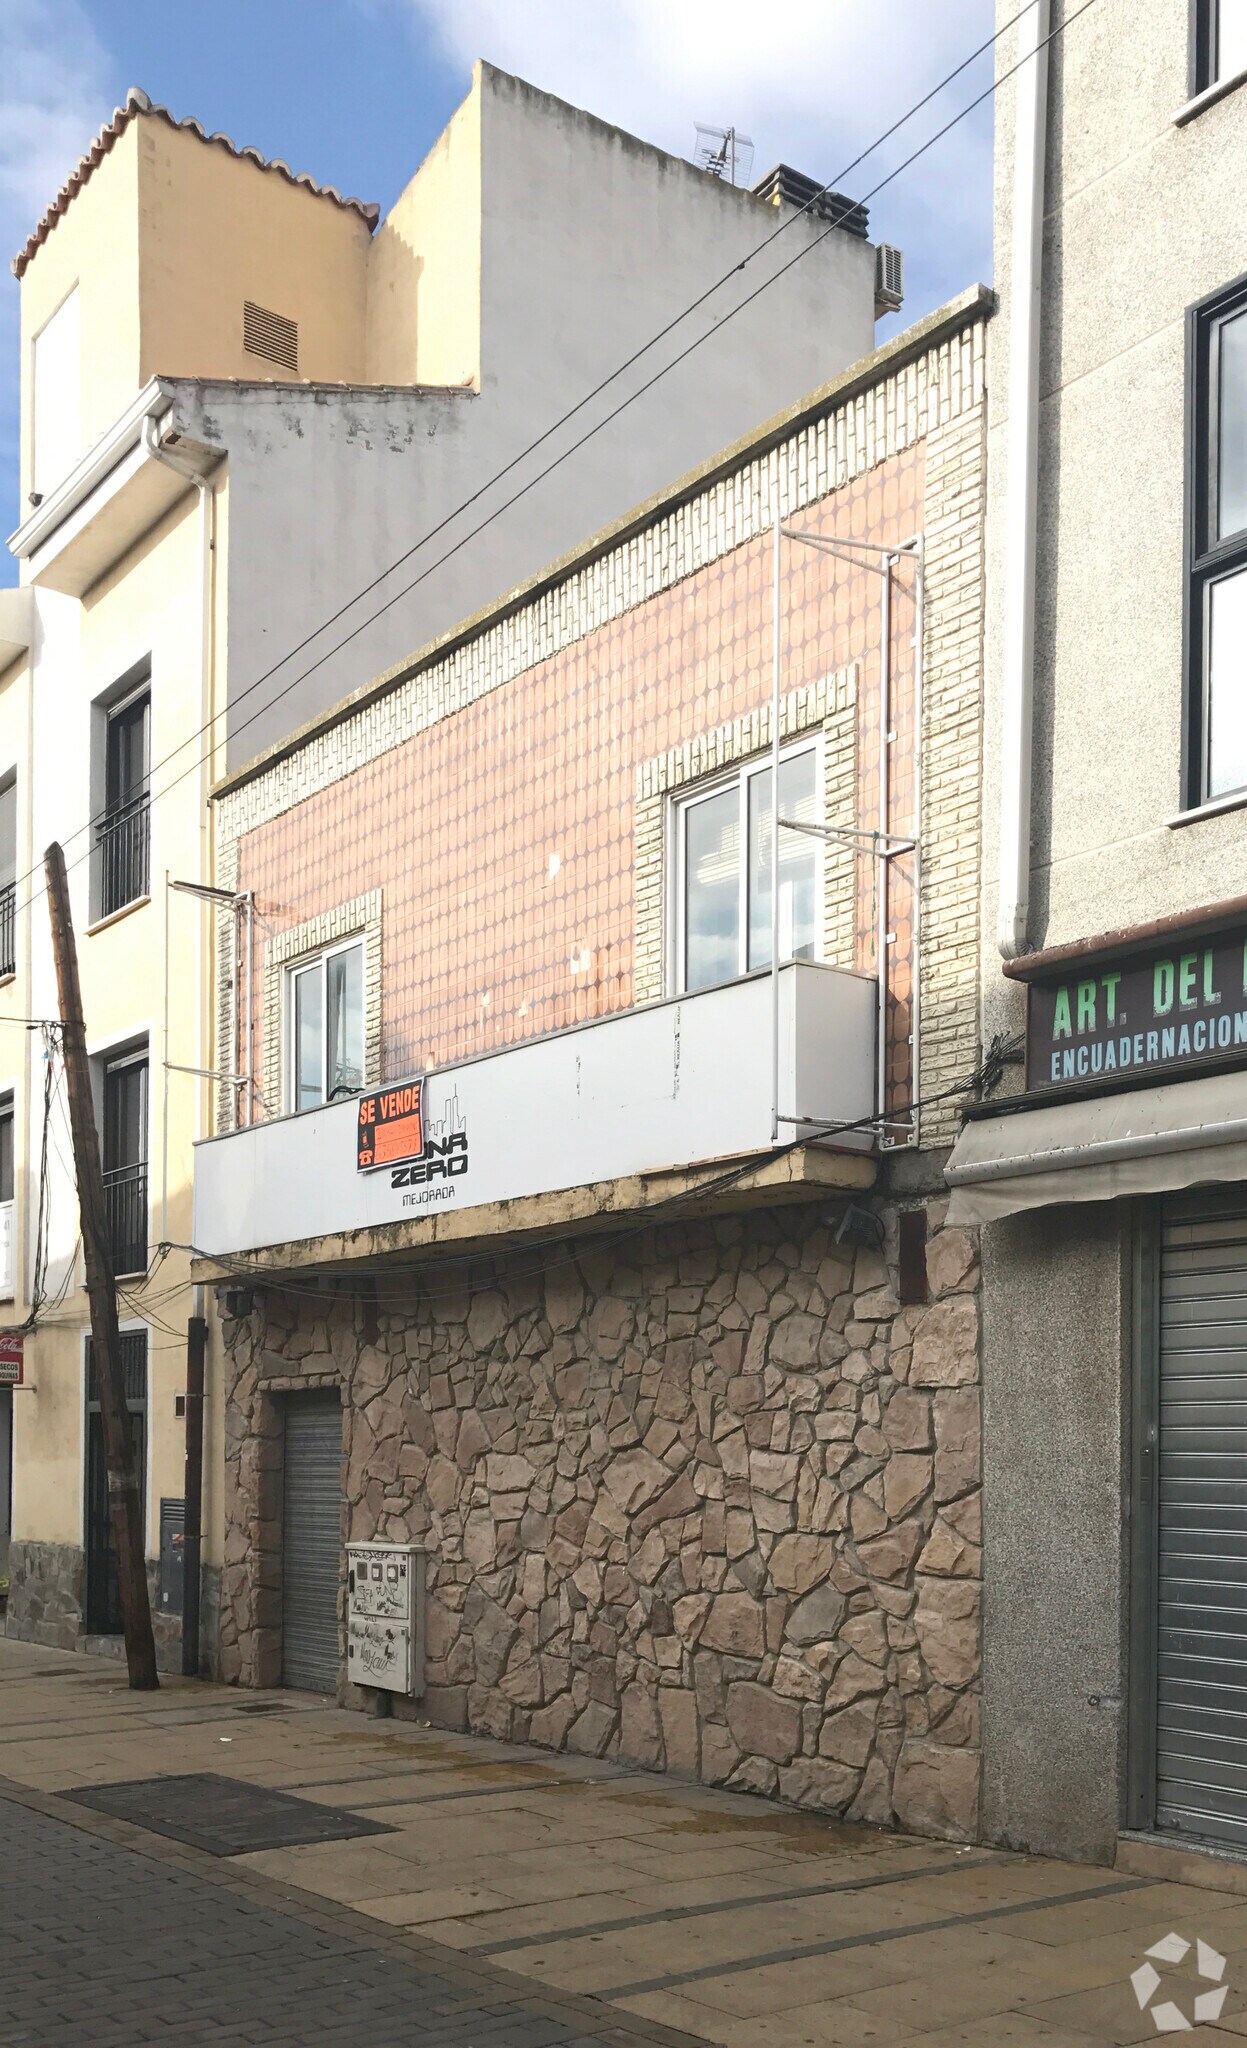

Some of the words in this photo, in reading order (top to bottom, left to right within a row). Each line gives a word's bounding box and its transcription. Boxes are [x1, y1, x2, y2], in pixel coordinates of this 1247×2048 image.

[1052, 971, 1127, 1041] ART.
[1153, 948, 1222, 1018] DEL
[1051, 1011, 1247, 1082] ENCUADERNACION
[360, 1099, 375, 1125] SE
[380, 1085, 420, 1119] VENDE
[391, 1154, 468, 1189] ZERO
[402, 1185, 456, 1207] MEJORADA
